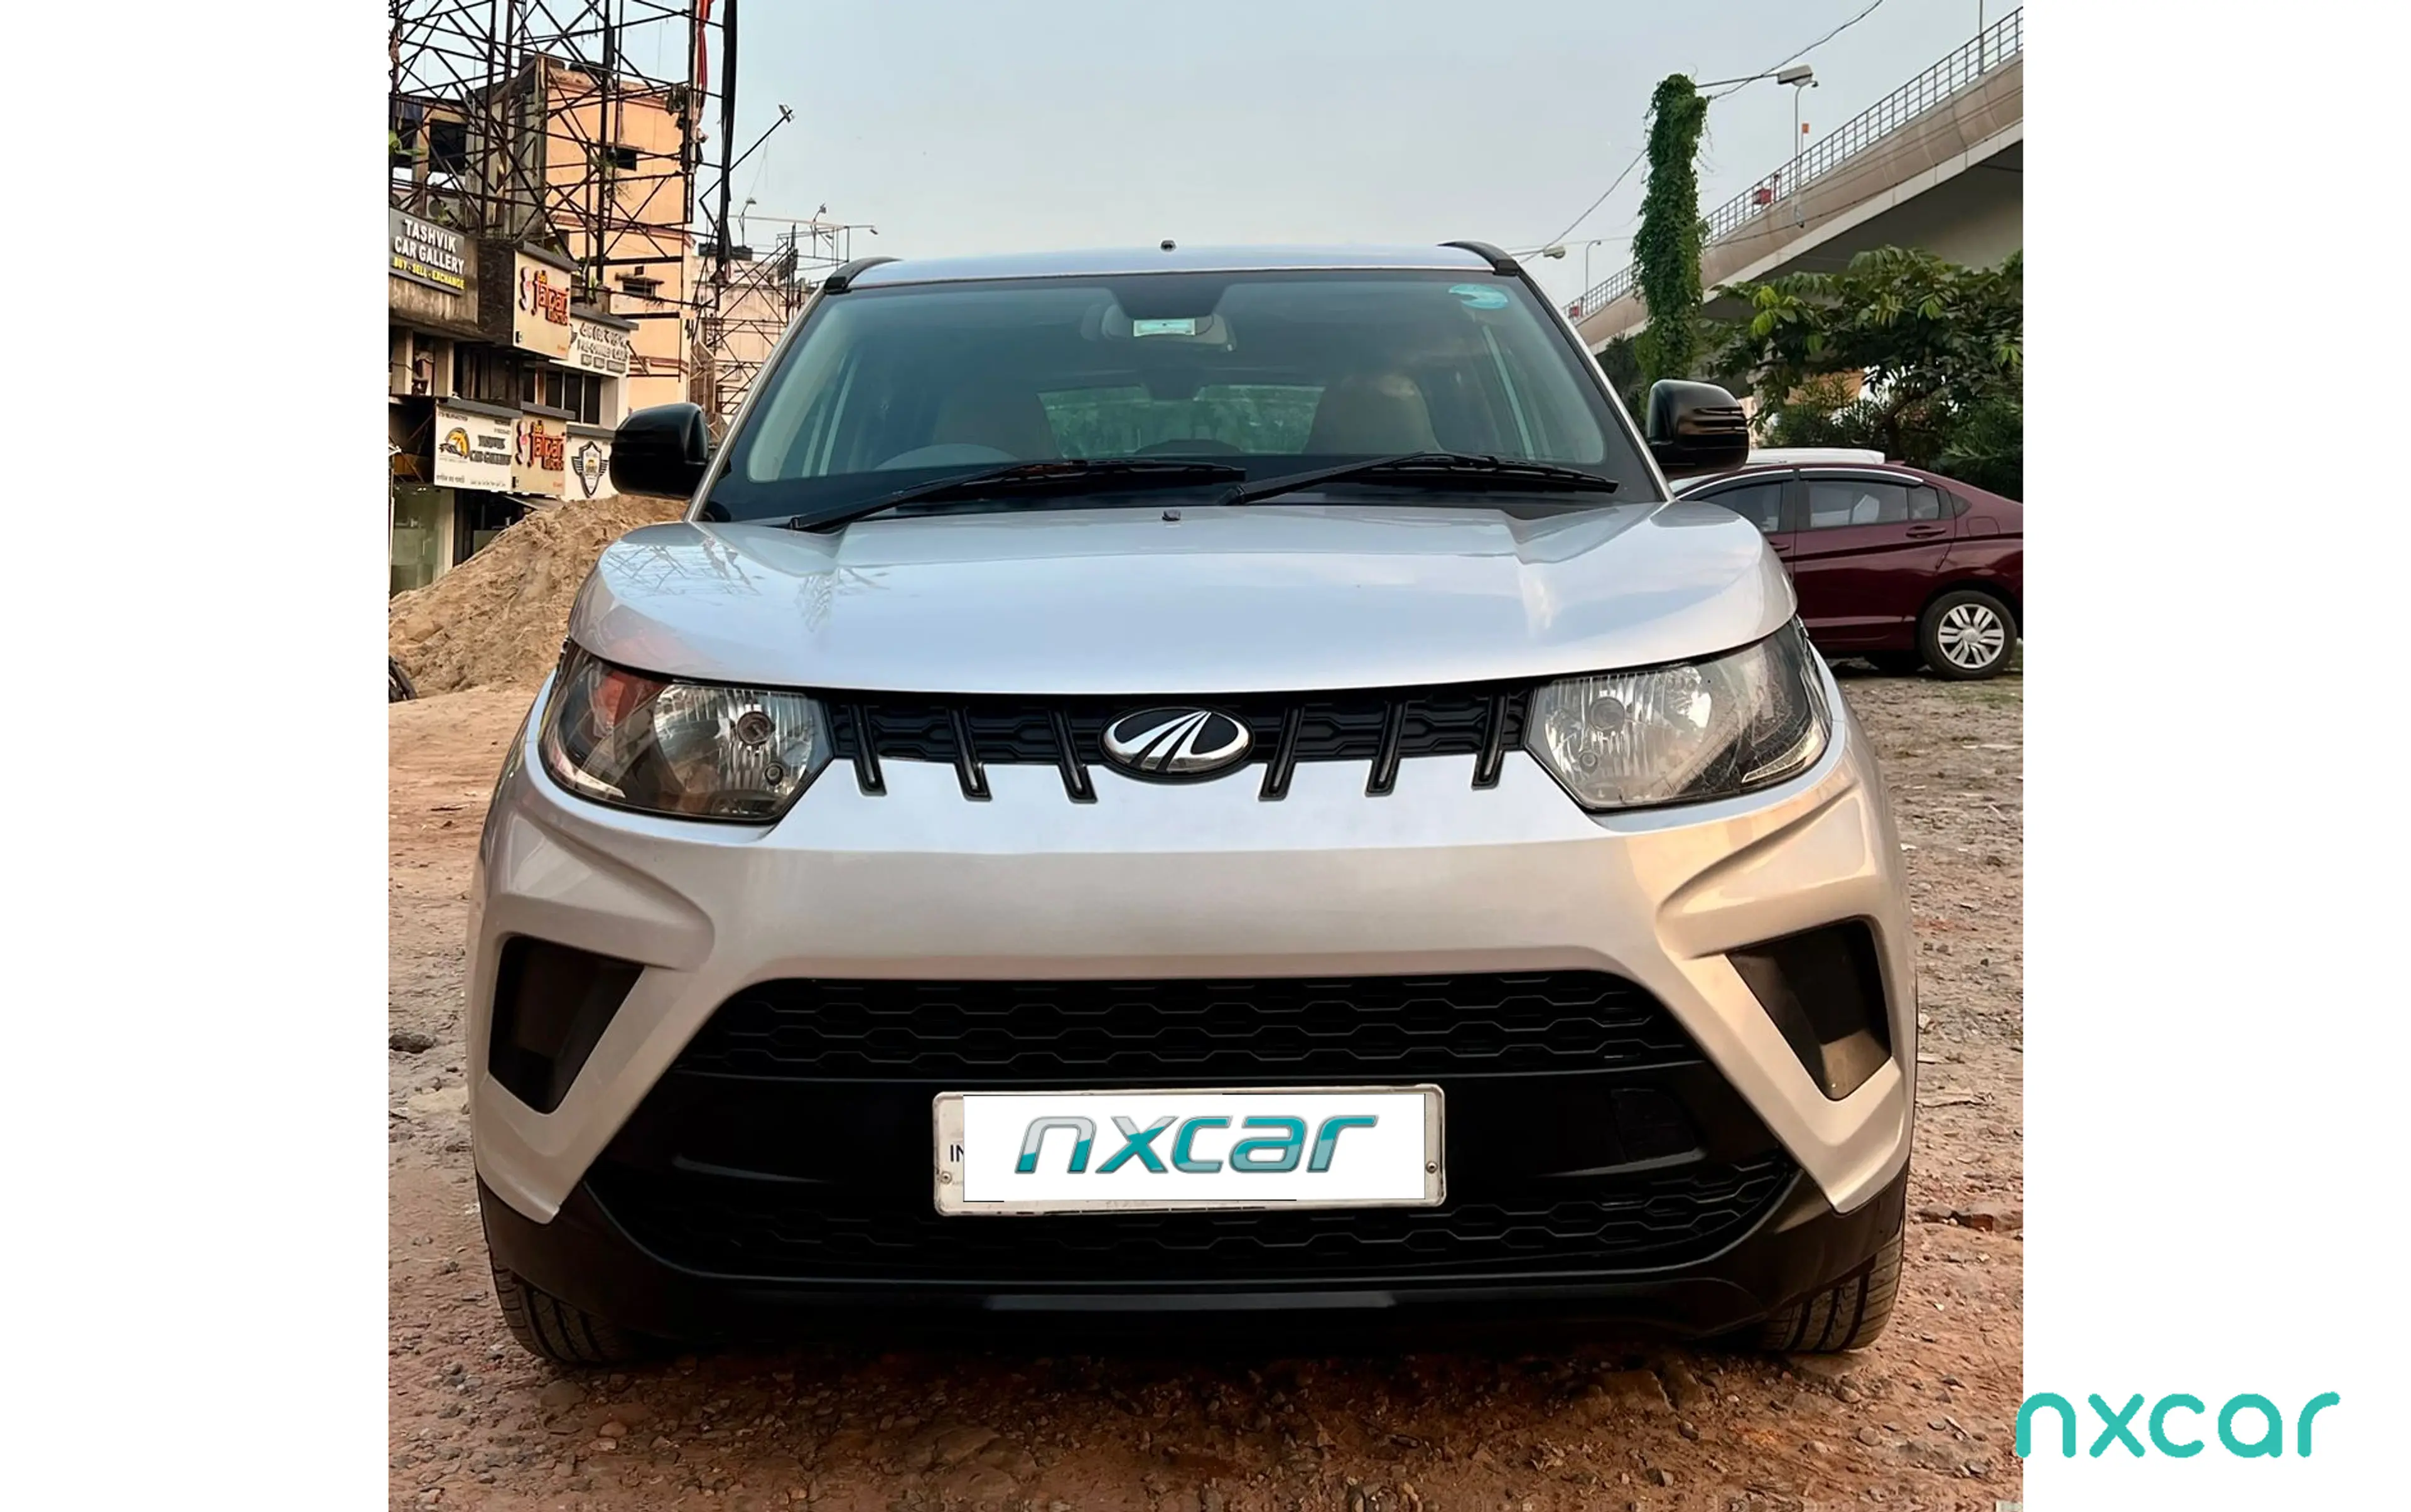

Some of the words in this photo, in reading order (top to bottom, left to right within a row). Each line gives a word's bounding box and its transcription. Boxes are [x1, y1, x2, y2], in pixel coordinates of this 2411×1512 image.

[404, 218, 456, 253] TASHVIK
[394, 235, 418, 260] CAR
[418, 245, 465, 274] GALLERY
[412, 263, 428, 278] SELL
